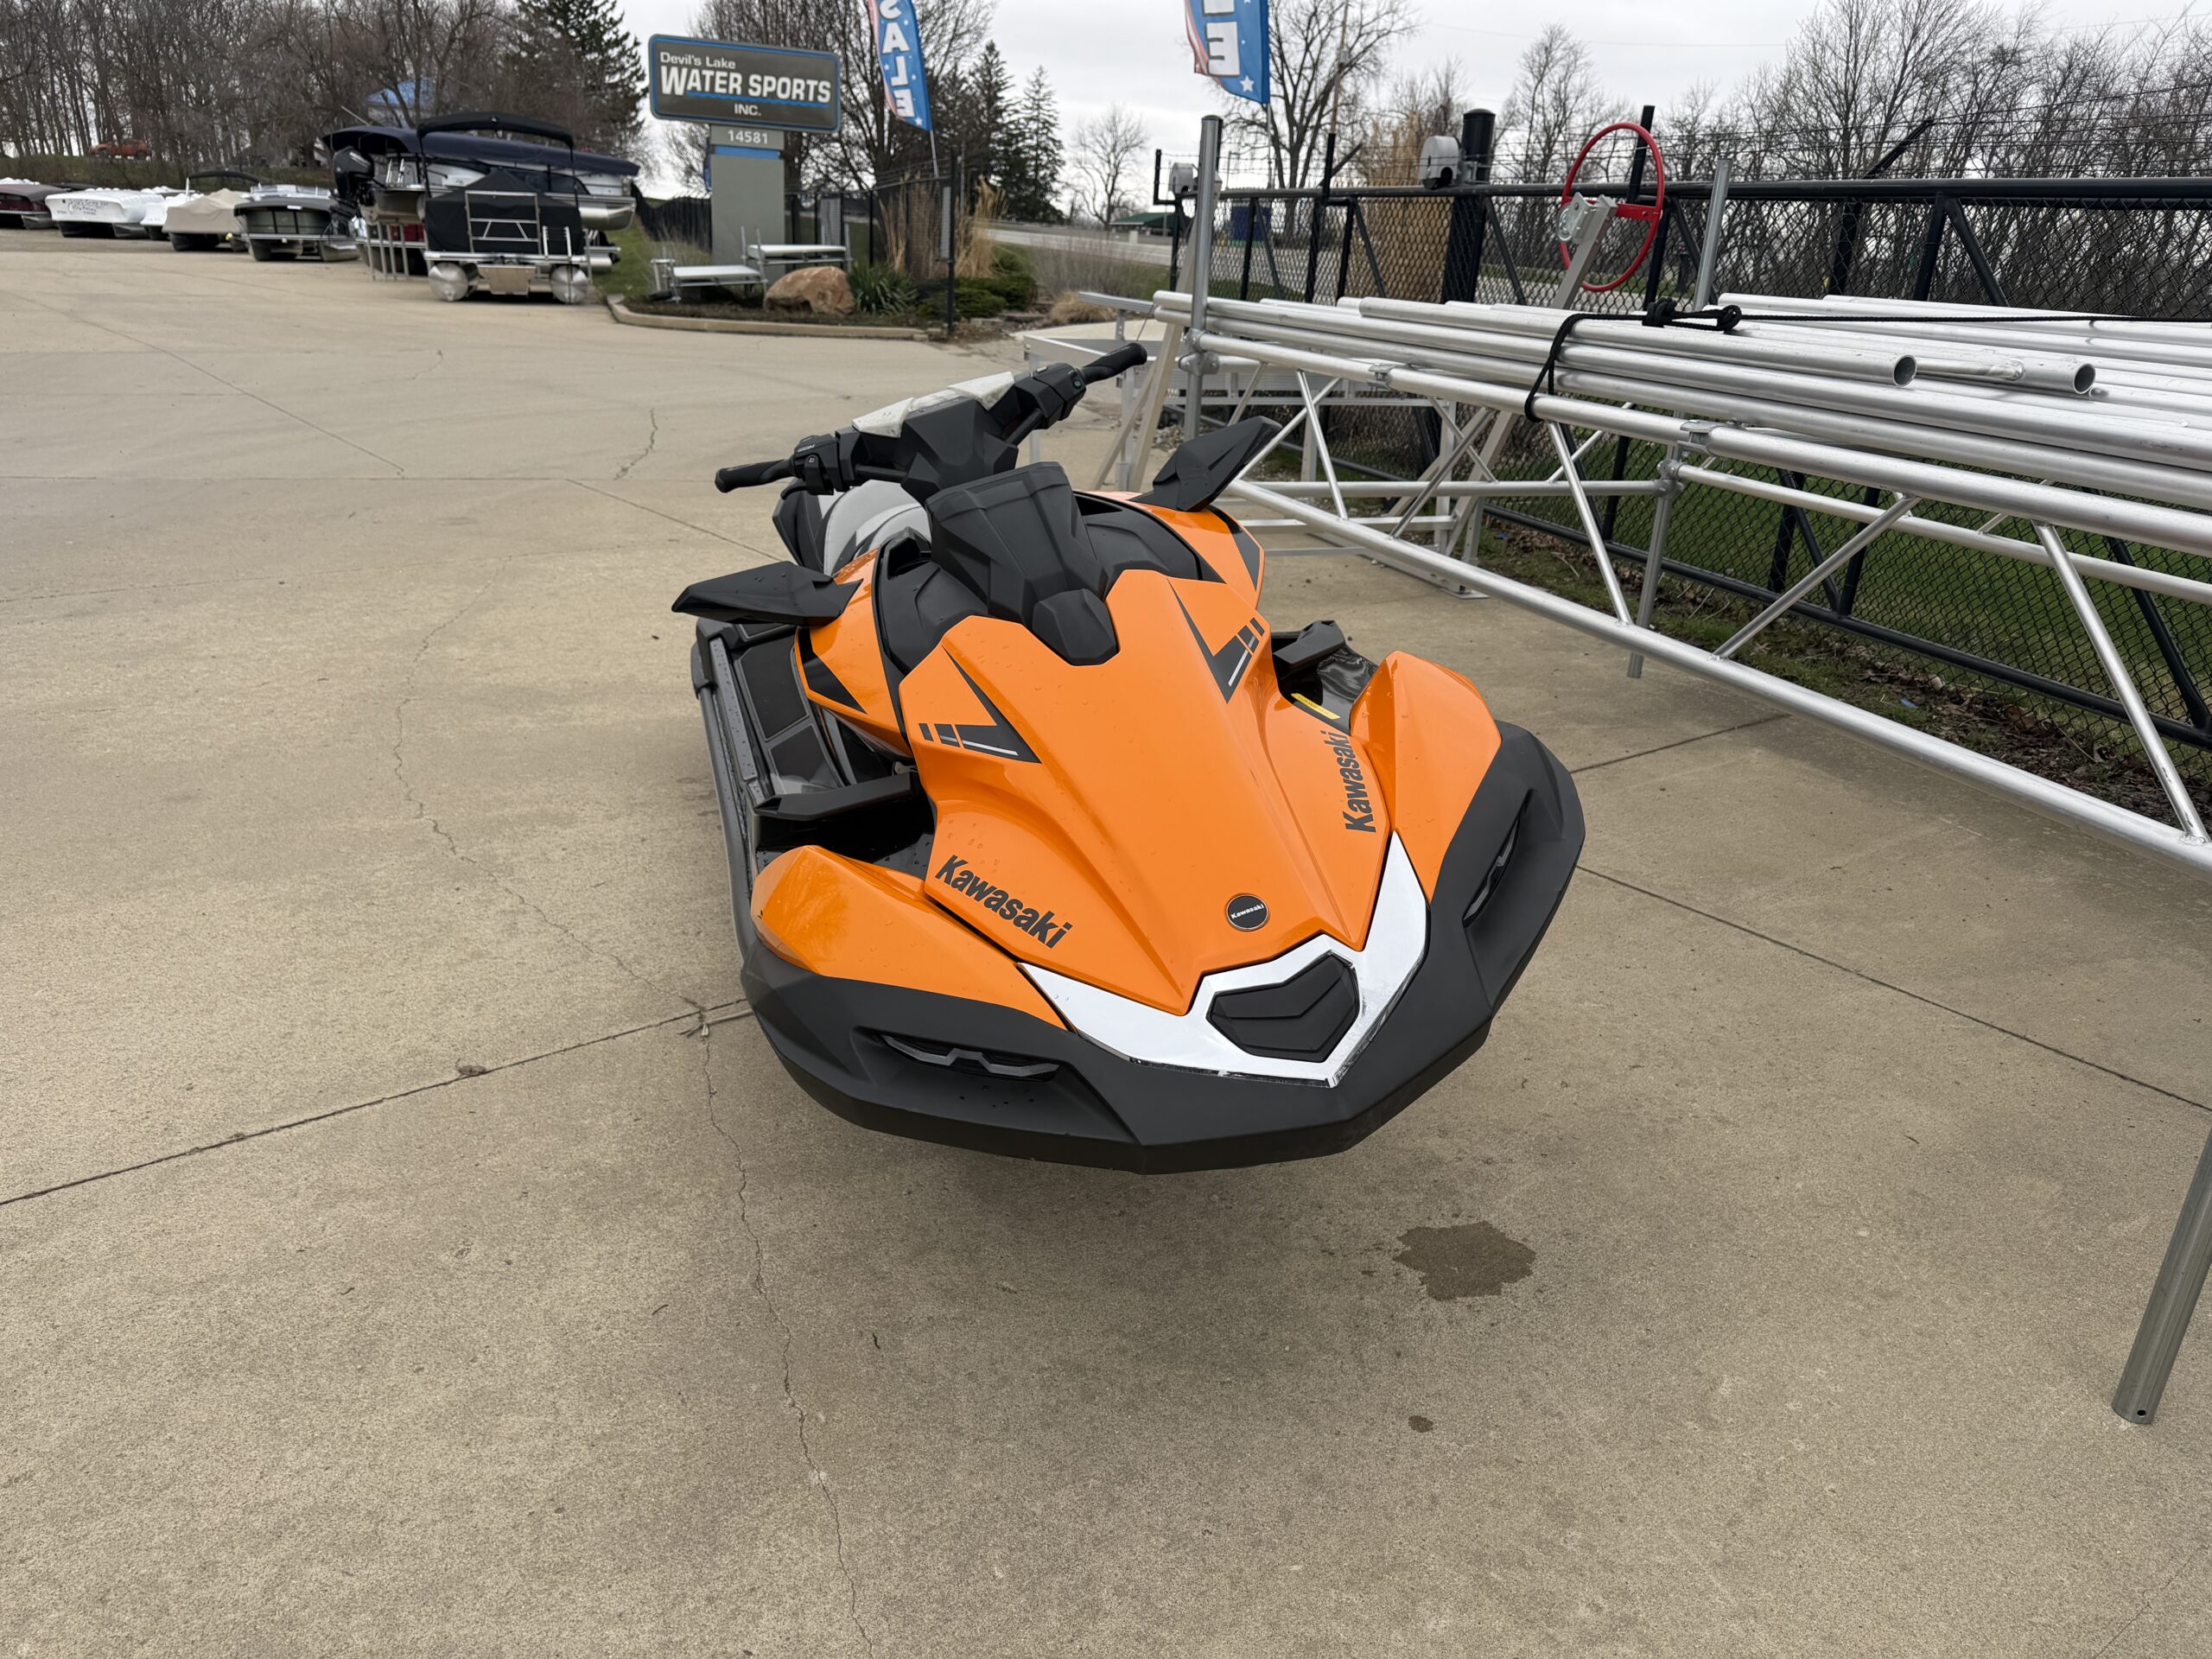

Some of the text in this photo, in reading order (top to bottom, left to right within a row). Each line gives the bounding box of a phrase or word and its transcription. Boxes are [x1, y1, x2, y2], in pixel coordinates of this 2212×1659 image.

[659, 51, 736, 70] Devil's Lake
[660, 65, 831, 104] WATER SPORTS
[734, 103, 762, 117] INC.
[728, 130, 769, 145] 14581
[1319, 730, 1376, 834] Kawasaki
[935, 854, 1073, 949] Kawasaki
[1230, 903, 1265, 919] Kawasaki
